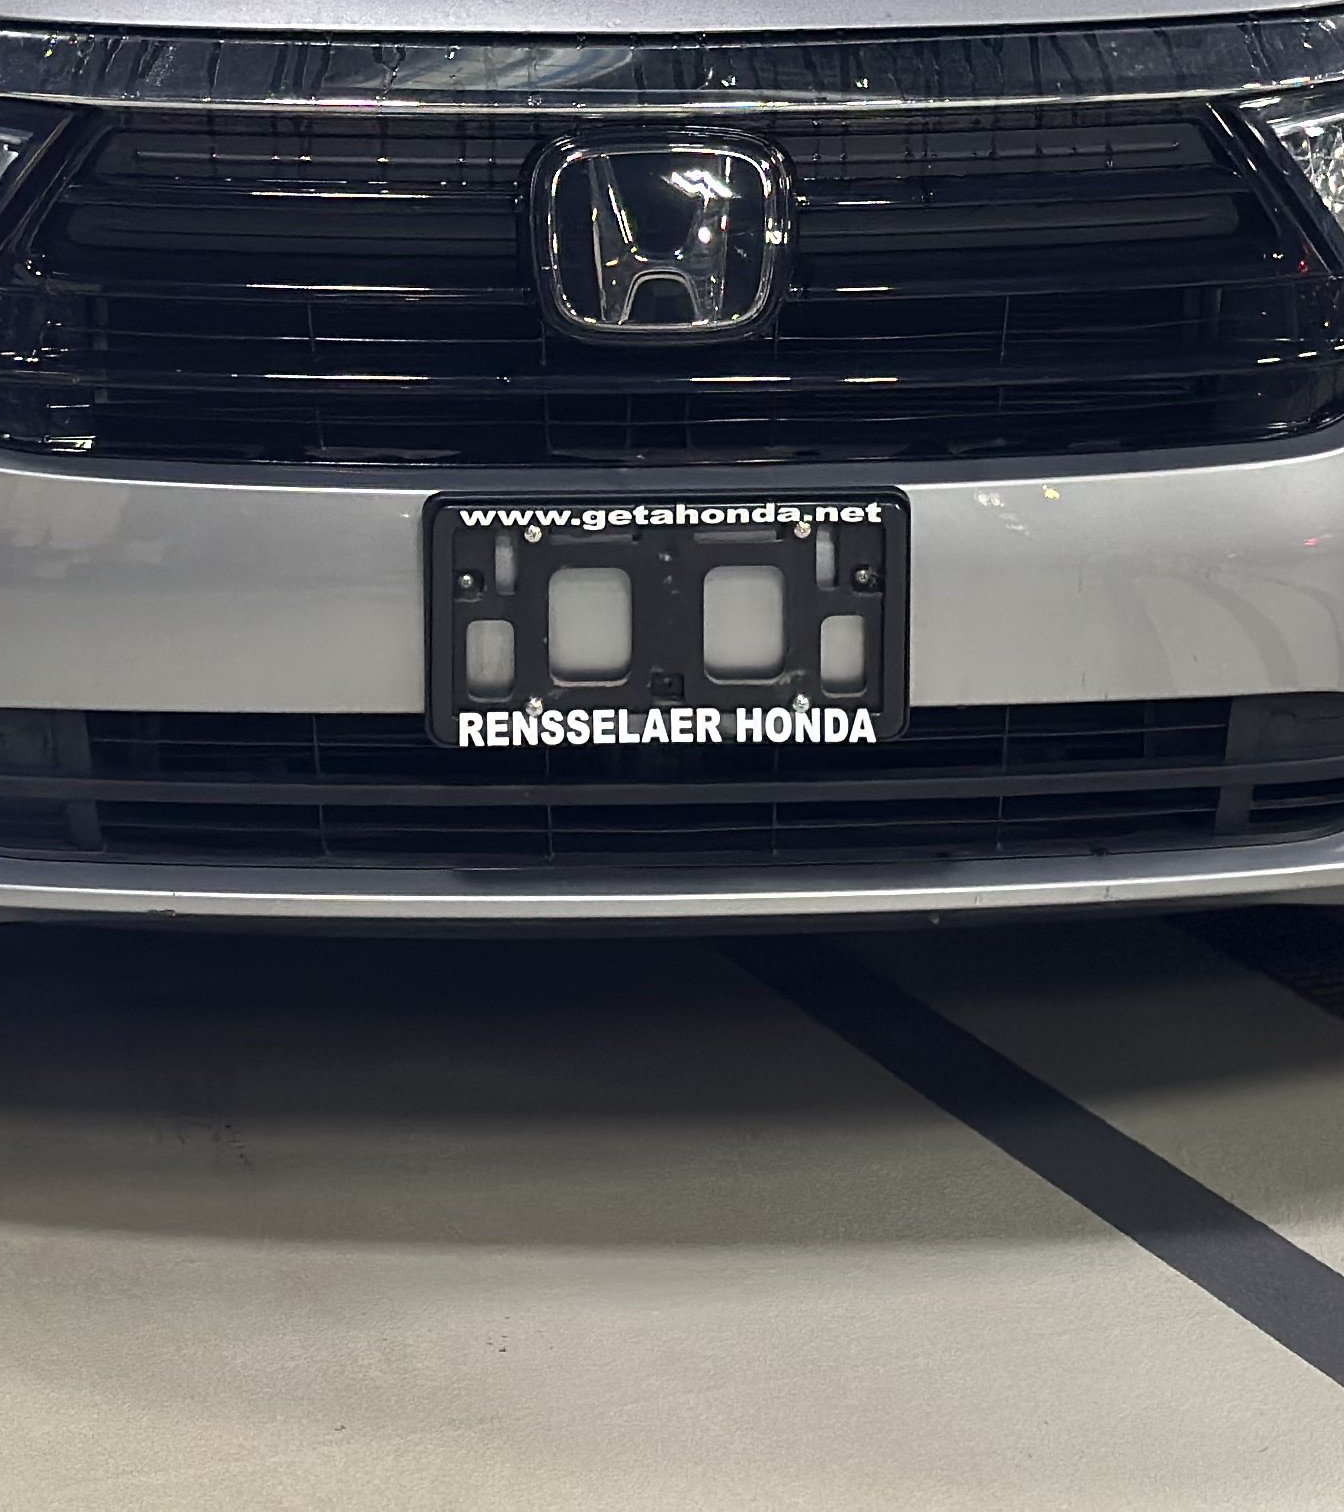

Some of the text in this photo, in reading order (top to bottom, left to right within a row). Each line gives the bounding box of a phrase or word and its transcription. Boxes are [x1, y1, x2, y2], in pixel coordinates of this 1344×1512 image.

[459, 502, 882, 530] www.getahonda.net
[458, 707, 876, 747] RENSSELAER HONDA
